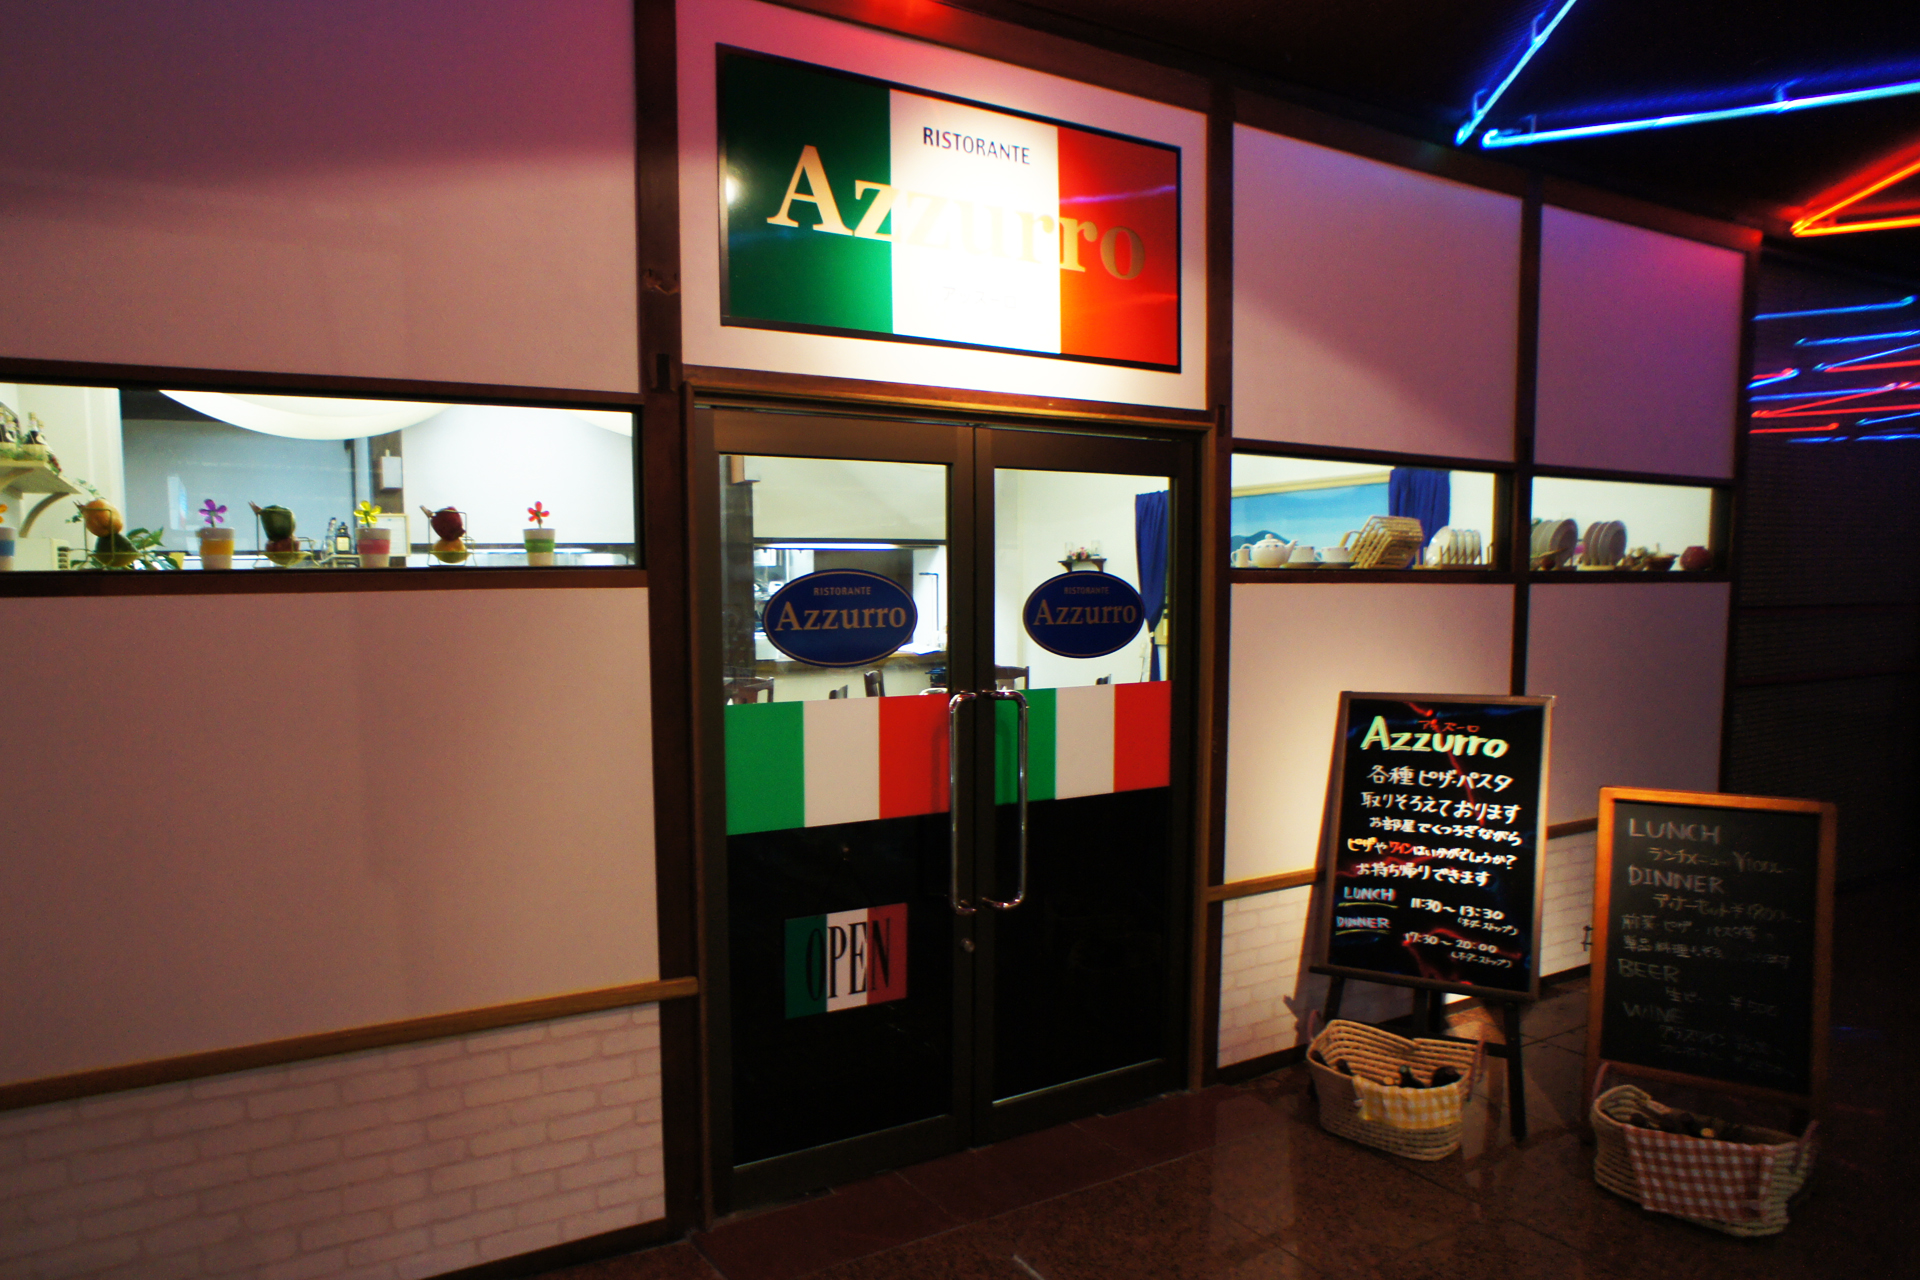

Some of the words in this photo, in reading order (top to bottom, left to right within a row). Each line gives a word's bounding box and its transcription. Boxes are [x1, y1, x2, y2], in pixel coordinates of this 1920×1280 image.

[923, 126, 1030, 165] RISTORANTE
[766, 144, 1145, 280] Azzurro
[813, 587, 872, 596] RISTORANTE
[1064, 586, 1110, 595] RISTORANTE
[775, 601, 907, 632] Azzurro
[1033, 599, 1137, 625] Azzurro
[1360, 715, 1509, 758] Azzurro
[1628, 818, 1721, 845] LUNCH
[1628, 864, 1725, 894] DINNER
[1343, 887, 1396, 901] LUNCH
[1336, 916, 1391, 928] DINNER
[806, 918, 890, 1001] OPEN
[1617, 958, 1681, 983] BEER
[1621, 1001, 1684, 1023] WINE
